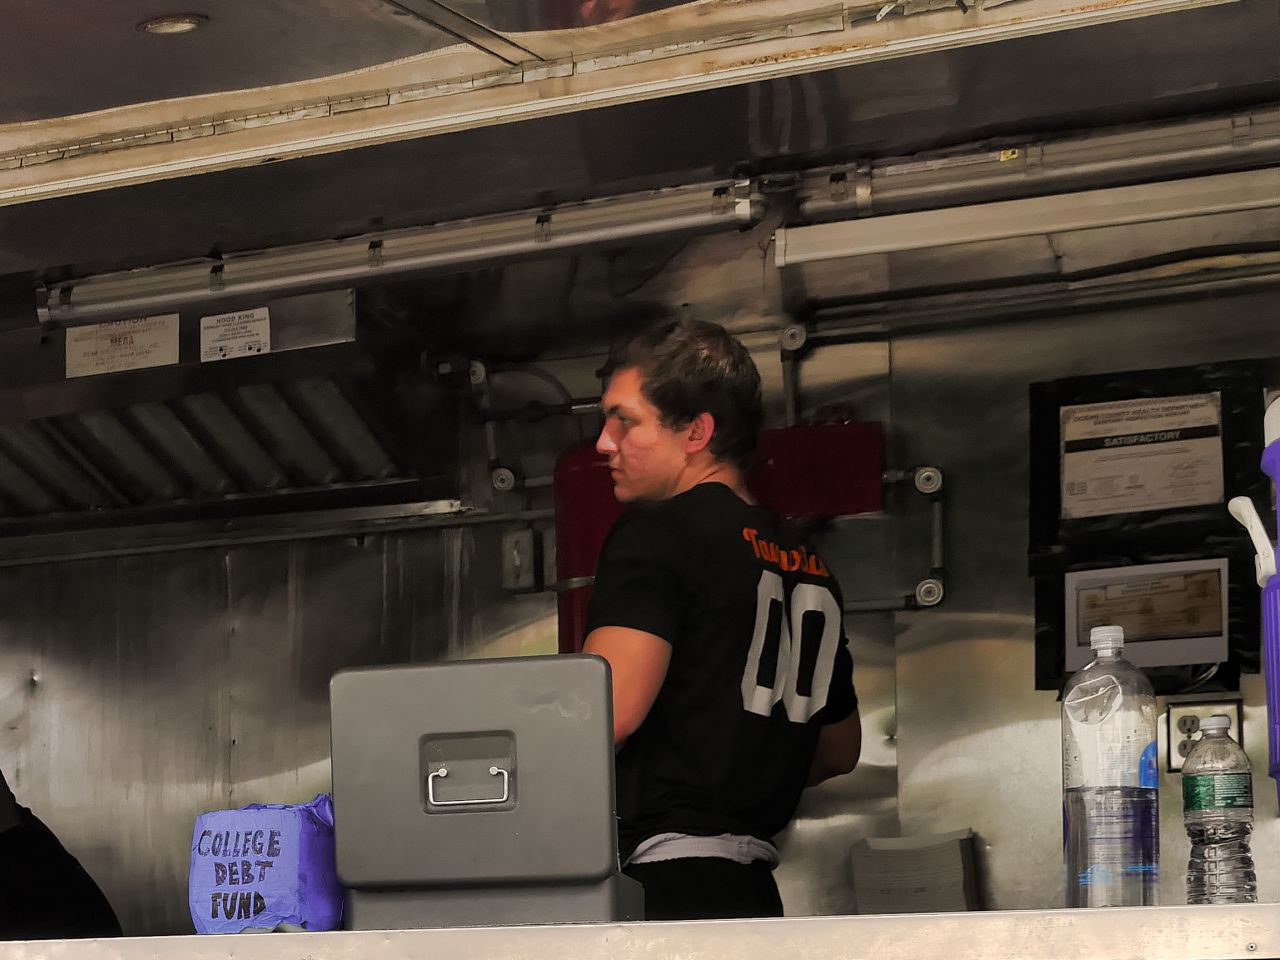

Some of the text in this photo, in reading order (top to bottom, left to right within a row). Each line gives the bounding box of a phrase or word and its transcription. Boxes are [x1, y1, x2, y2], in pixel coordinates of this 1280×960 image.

[1104, 431, 1181, 447] SATISFACTORY
[198, 829, 282, 858] COLLEGE
[214, 860, 273, 886] DEBT
[210, 891, 267, 920] FUND
